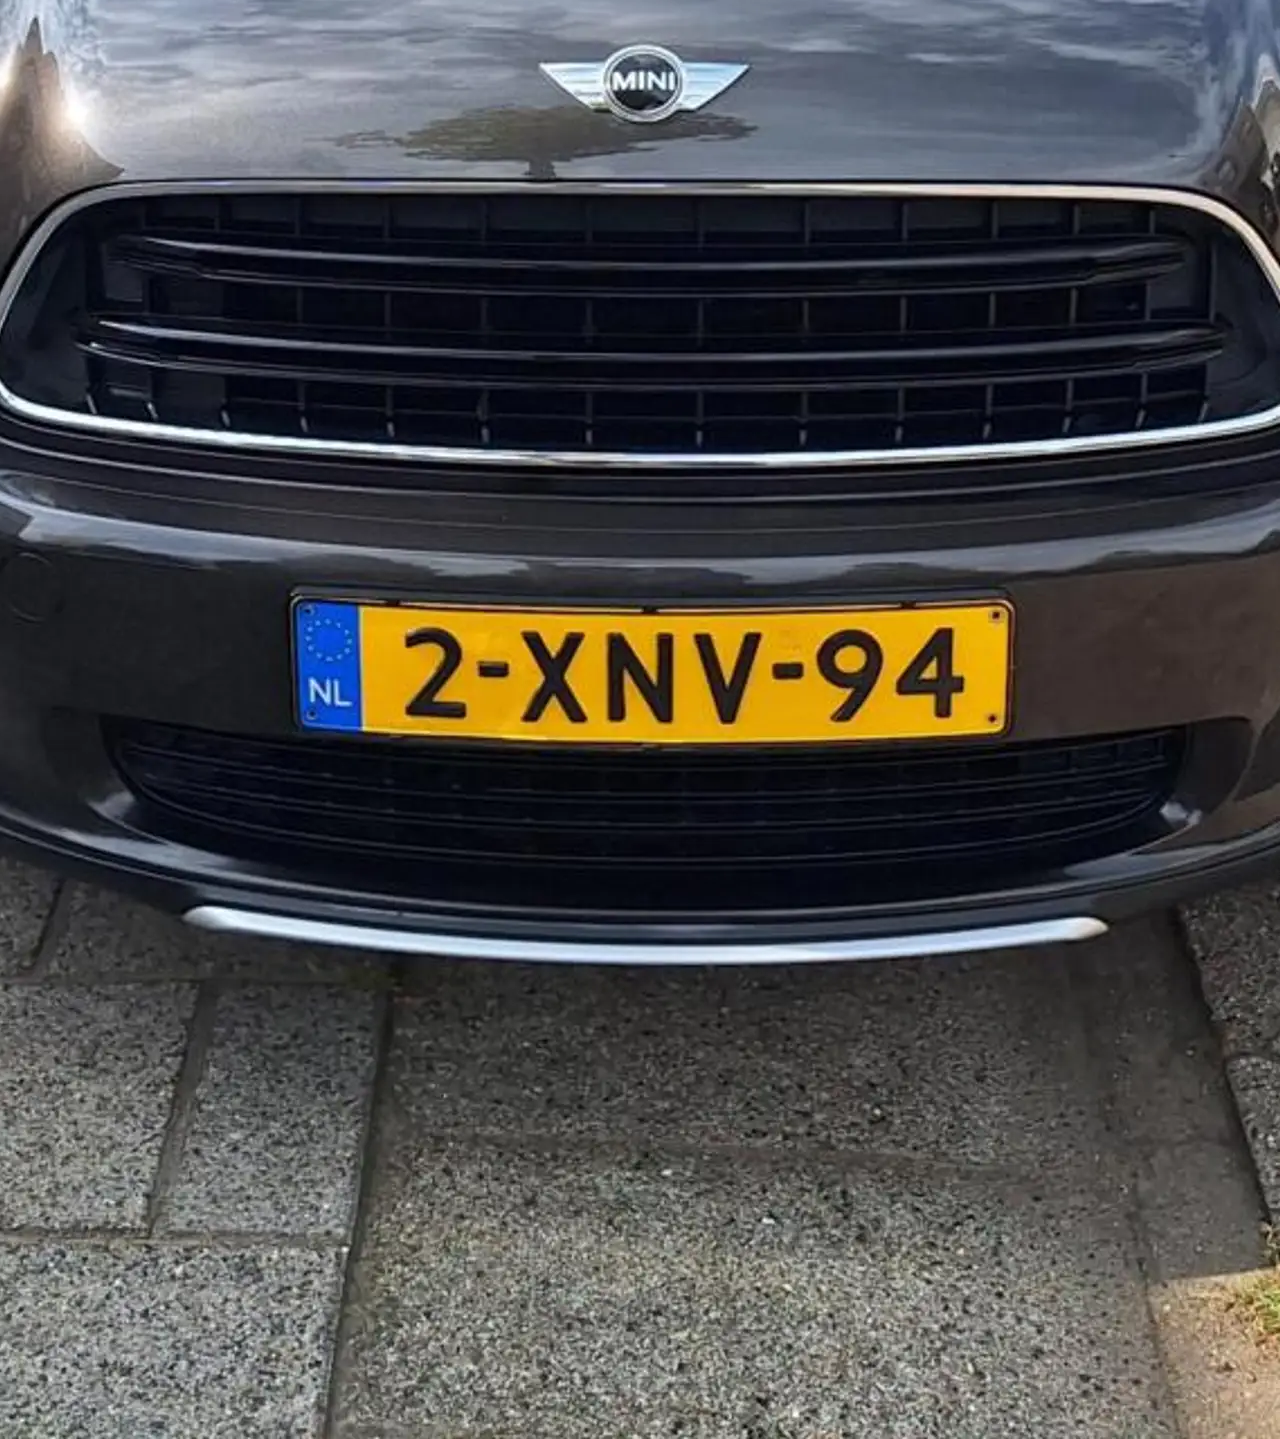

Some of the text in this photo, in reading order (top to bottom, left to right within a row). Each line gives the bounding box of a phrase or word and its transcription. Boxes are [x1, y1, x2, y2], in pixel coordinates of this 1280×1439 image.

[610, 70, 676, 91] MINI
[307, 626, 966, 725] NL 2-XNV-94
